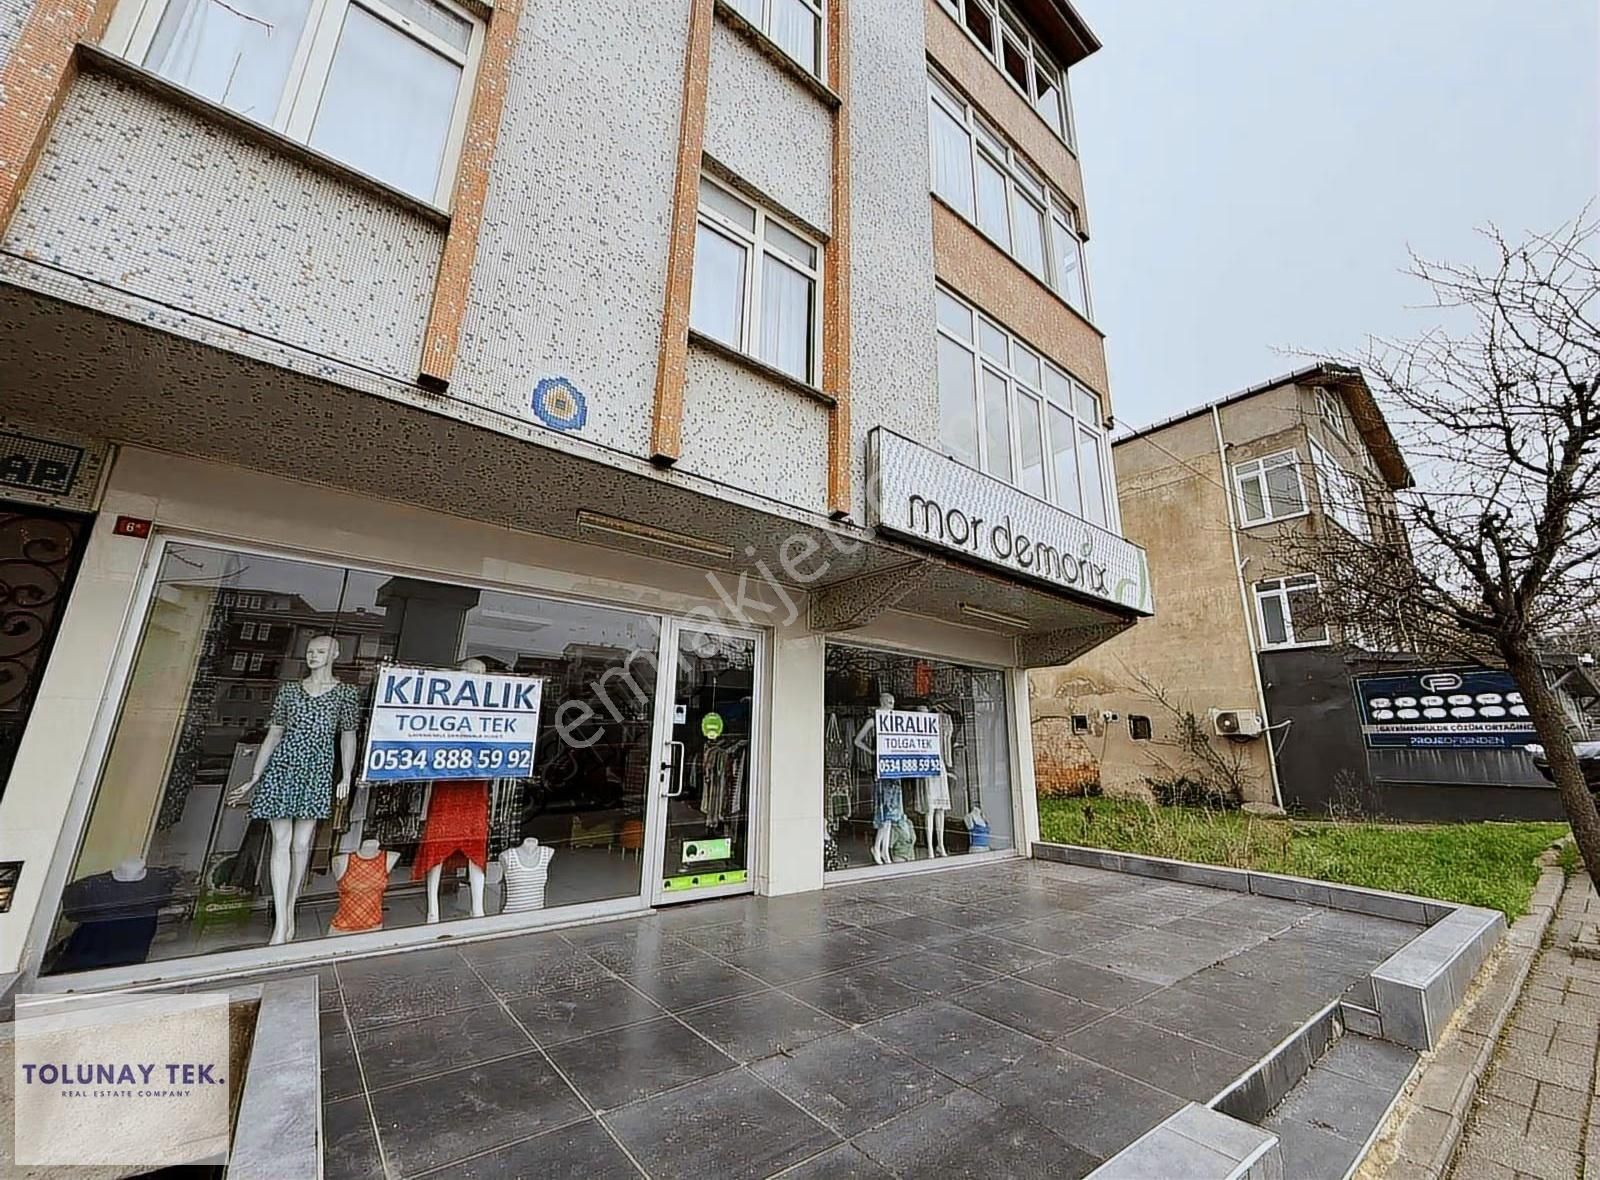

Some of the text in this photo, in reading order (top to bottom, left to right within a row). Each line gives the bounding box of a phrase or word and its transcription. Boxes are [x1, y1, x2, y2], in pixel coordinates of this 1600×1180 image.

[909, 494, 983, 550] mor
[384, 670, 536, 709] KİRALIK
[396, 714, 518, 733] TOLGA TEK
[879, 711, 938, 733] KİRALIK
[886, 738, 933, 749] TOLGA TEK
[370, 749, 532, 770] 0534 888 59 92
[880, 759, 900, 772] 0534
[902, 759, 918, 772] 888
[918, 759, 930, 772] 59
